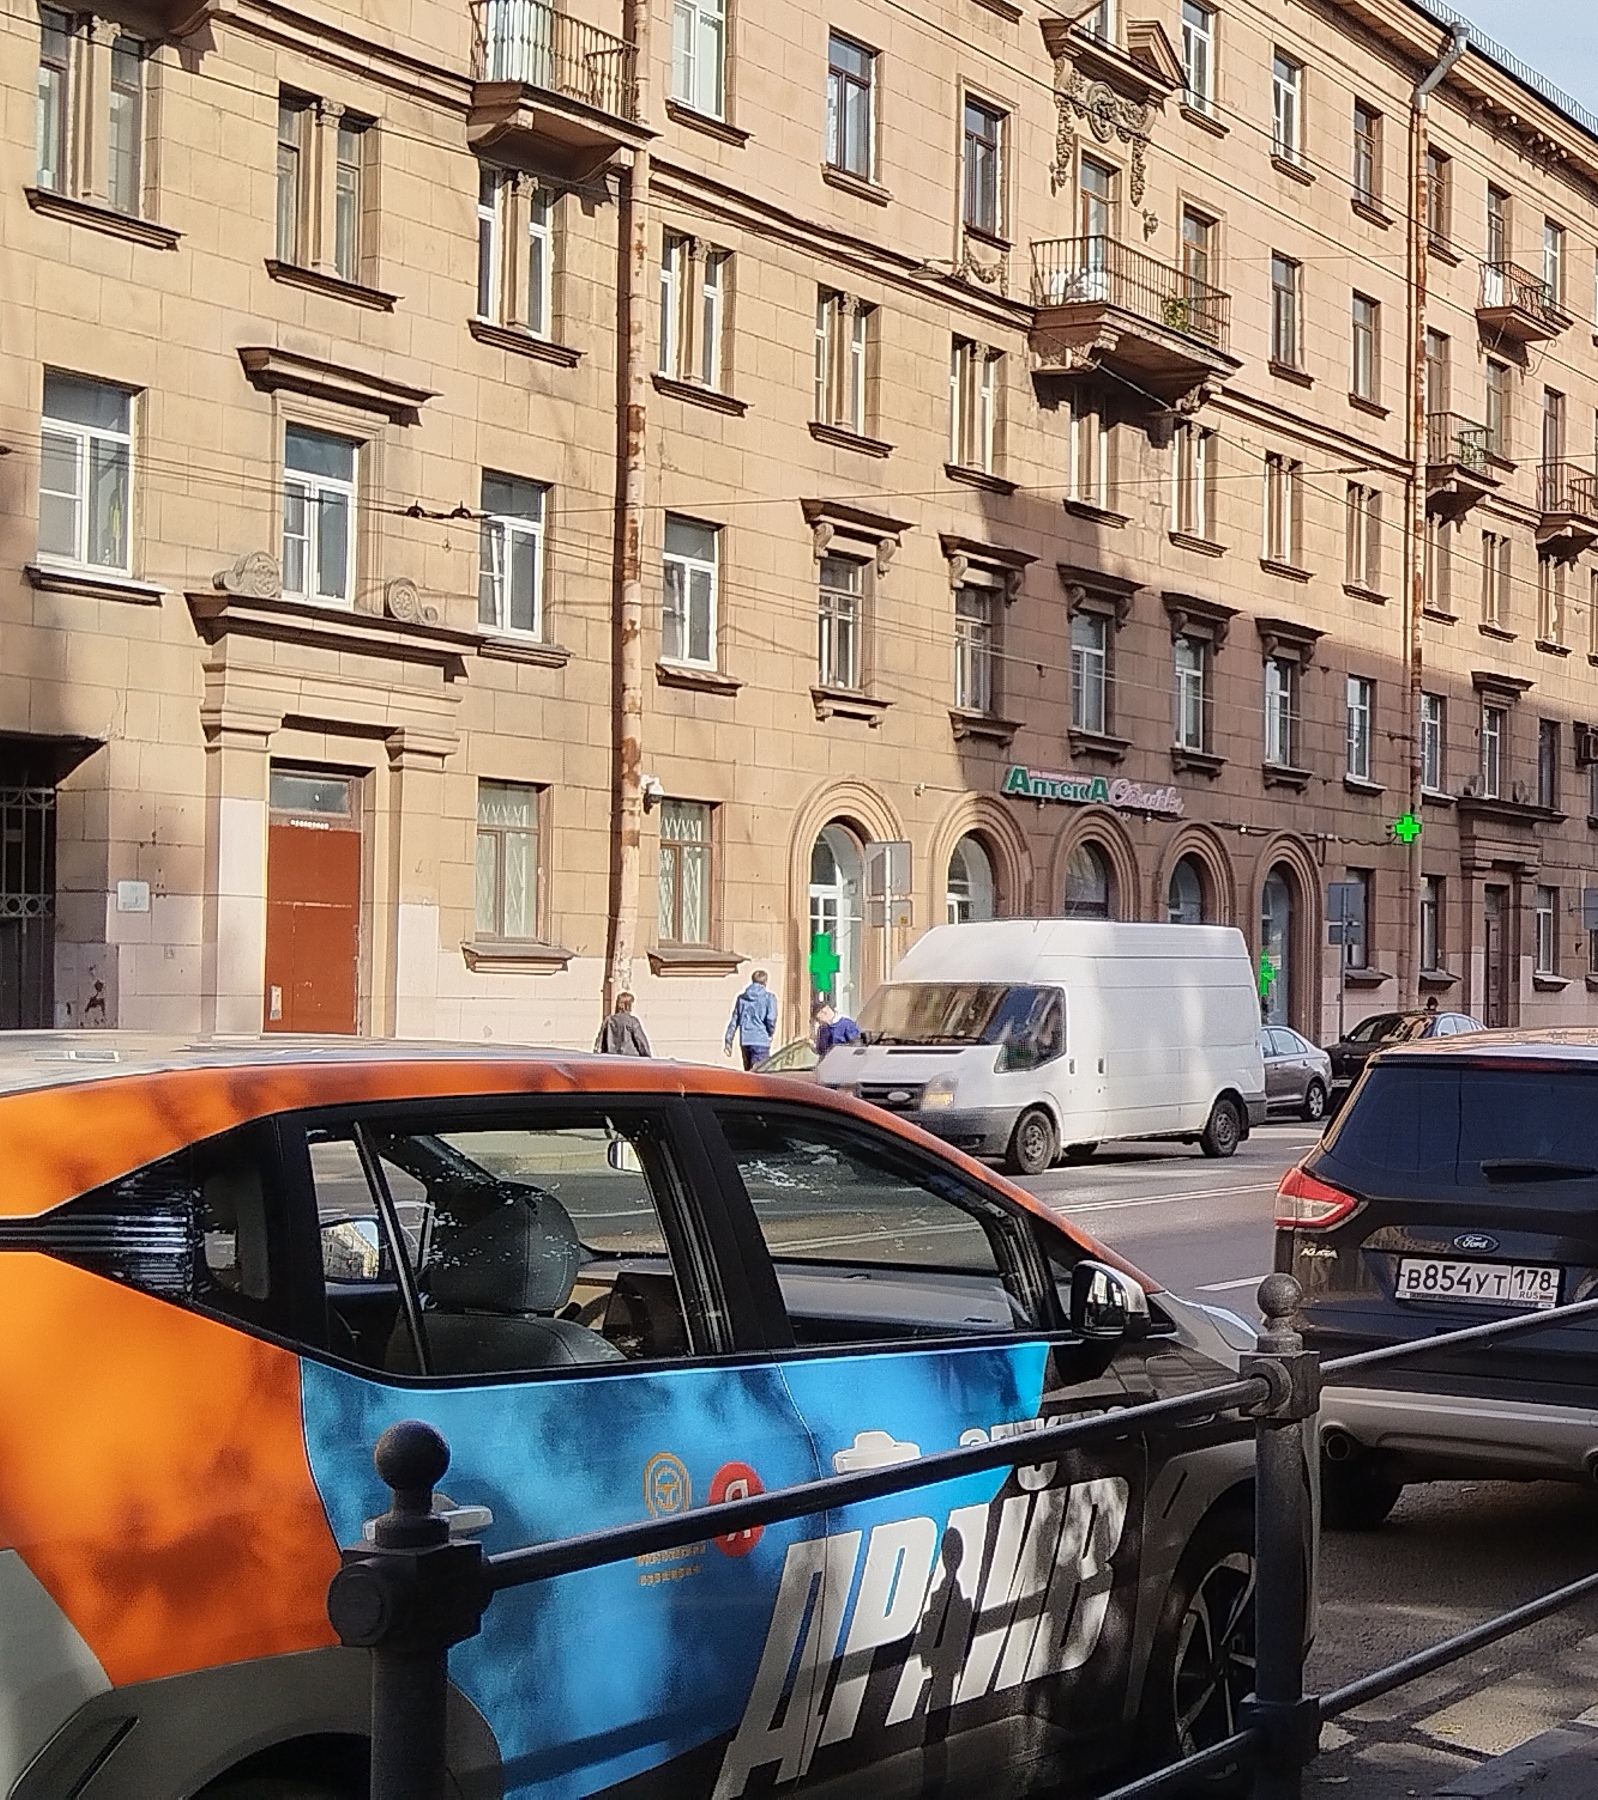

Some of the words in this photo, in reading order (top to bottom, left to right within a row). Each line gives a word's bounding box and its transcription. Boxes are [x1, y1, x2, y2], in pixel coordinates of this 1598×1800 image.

[1461, 1234, 1489, 1249] Ford
[1406, 1264, 1508, 1296] В854УТ
[1513, 1269, 1552, 1291] 178
[1518, 1290, 1539, 1299] RUS
[711, 1461, 1131, 1800] ДРАЙВ
